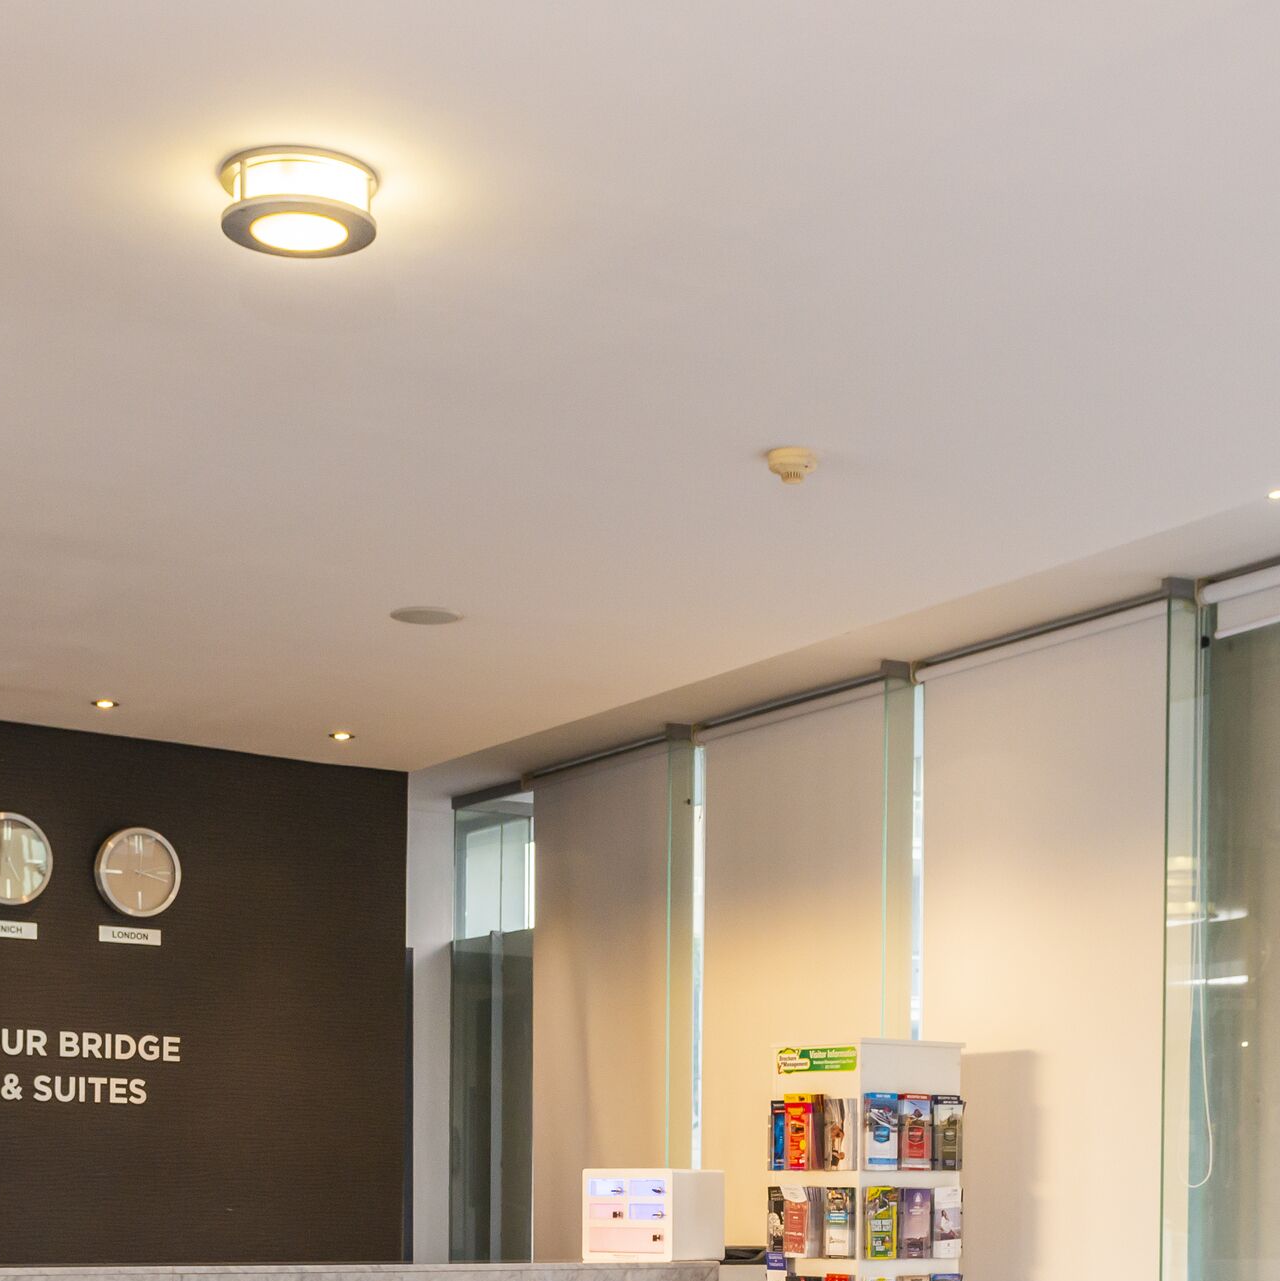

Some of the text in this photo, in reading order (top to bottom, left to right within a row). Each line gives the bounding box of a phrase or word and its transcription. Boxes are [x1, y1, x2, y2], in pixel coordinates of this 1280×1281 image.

[111, 930, 149, 941] LONDON
[59, 1031, 181, 1062] BRIDGE
[0, 1073, 23, 1100] &
[33, 1075, 147, 1105] SUITES
